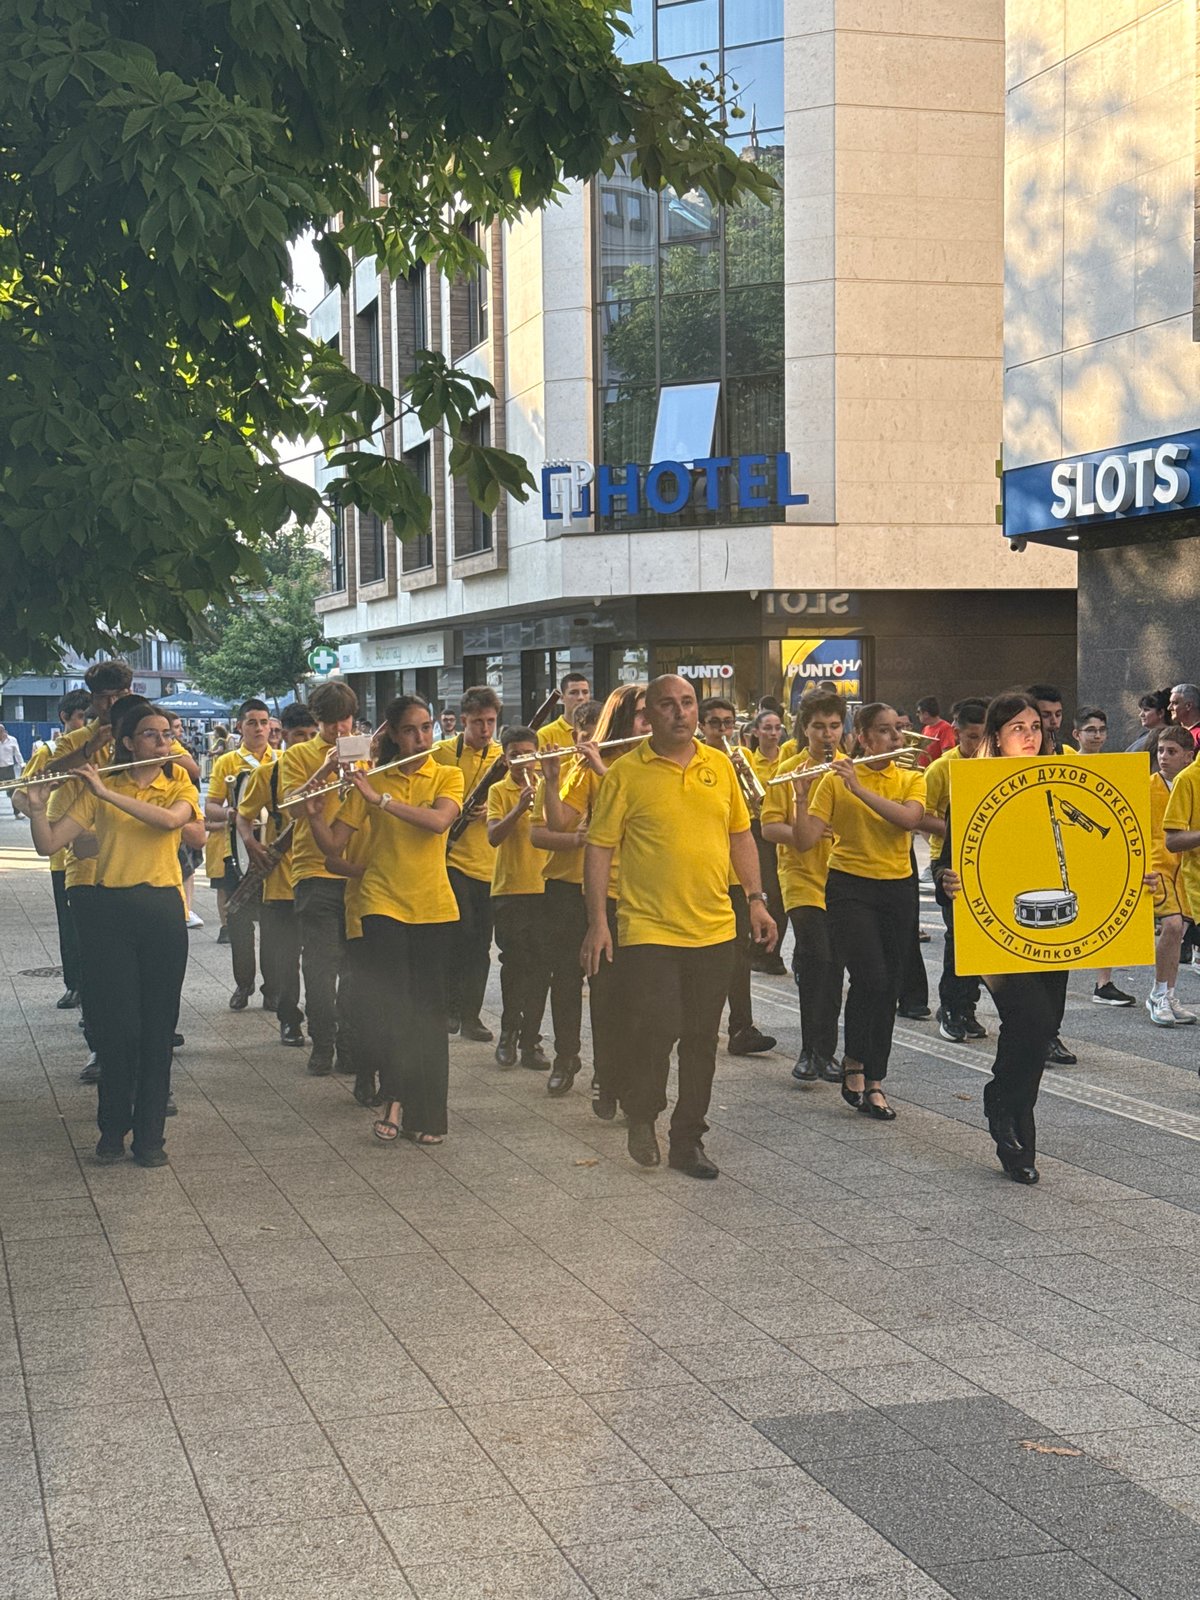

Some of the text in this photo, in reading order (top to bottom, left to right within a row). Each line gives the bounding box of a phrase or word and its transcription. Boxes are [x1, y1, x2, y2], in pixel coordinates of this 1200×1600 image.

[599, 452, 809, 516] HOTEL
[1051, 443, 1190, 519] SLOTS
[677, 664, 733, 679] PUNTO
[788, 664, 846, 677] PUNTO
[965, 767, 1142, 866] УЧЕНИЧЕСКИ ДУХОВ ОРКЕСТЪР
[972, 897, 994, 927] НУИ
